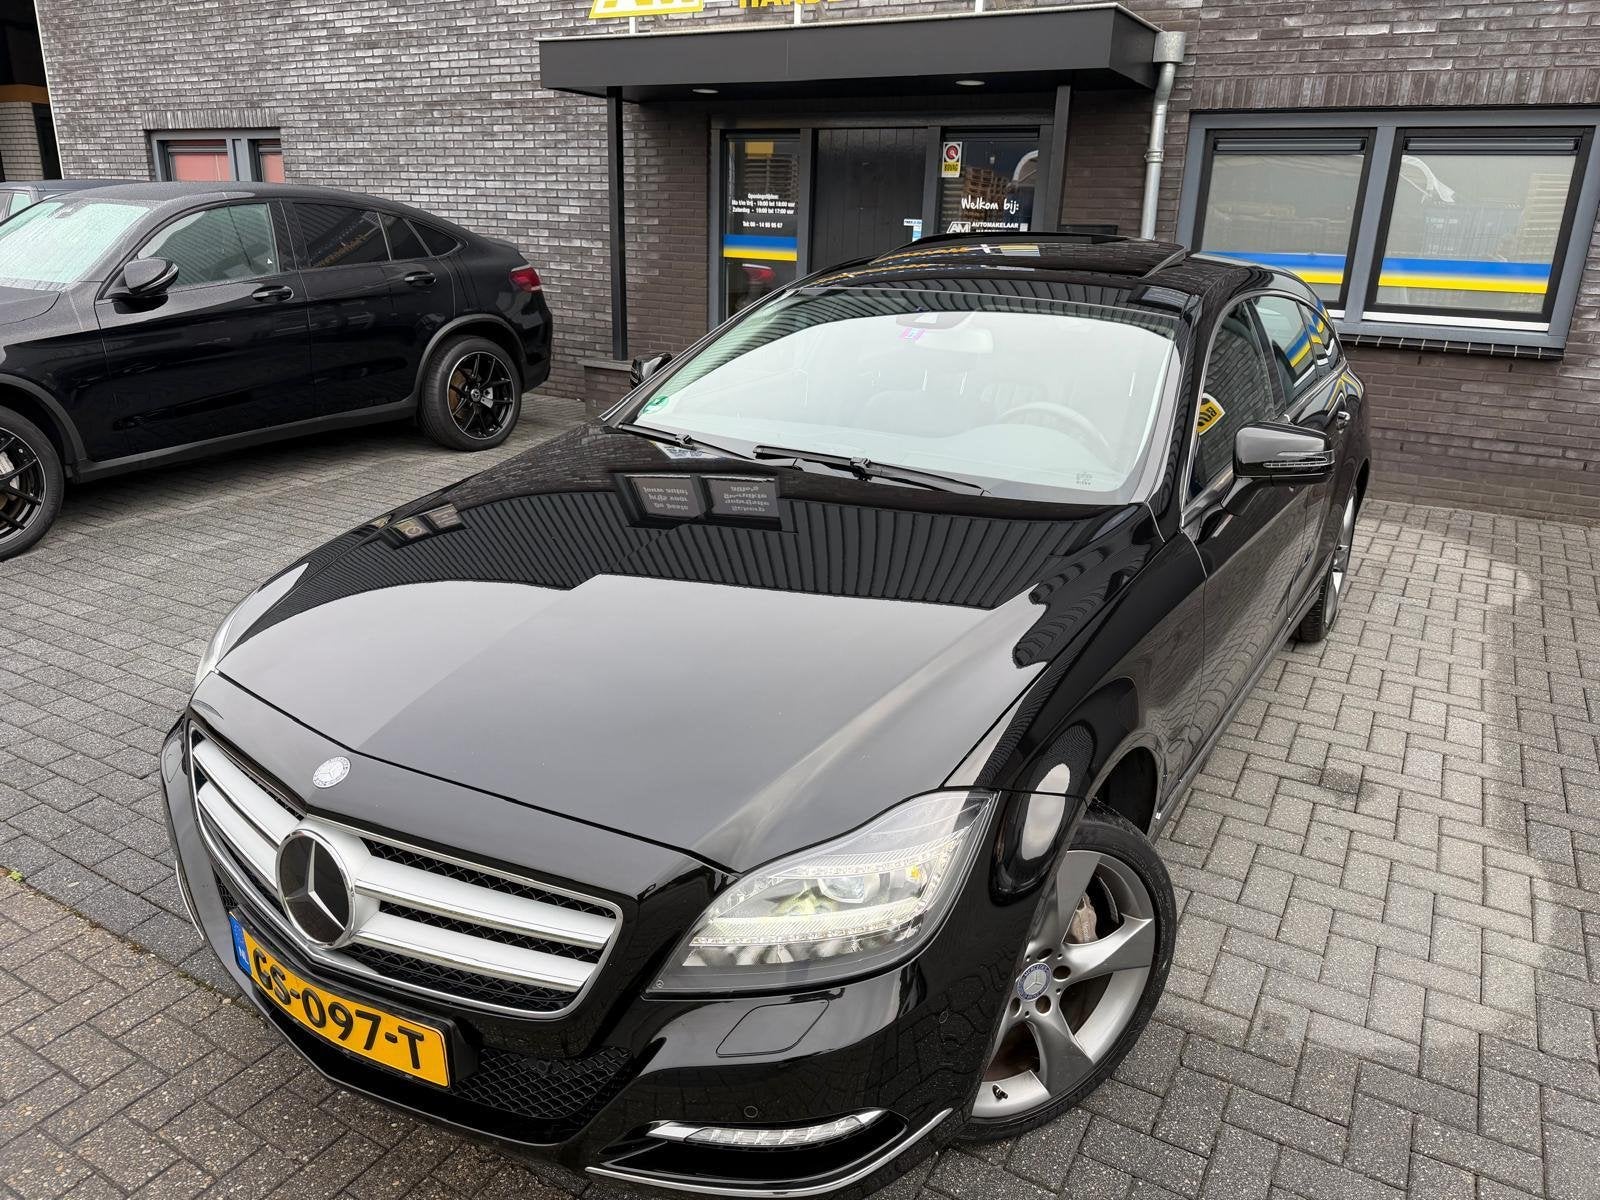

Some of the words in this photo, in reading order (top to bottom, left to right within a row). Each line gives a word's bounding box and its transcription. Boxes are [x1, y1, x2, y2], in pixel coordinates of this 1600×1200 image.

[961, 195, 999, 210] Welkom
[1003, 199, 1020, 215] bij:
[947, 222, 970, 233] AM
[253, 947, 425, 1070] GS-097-T
